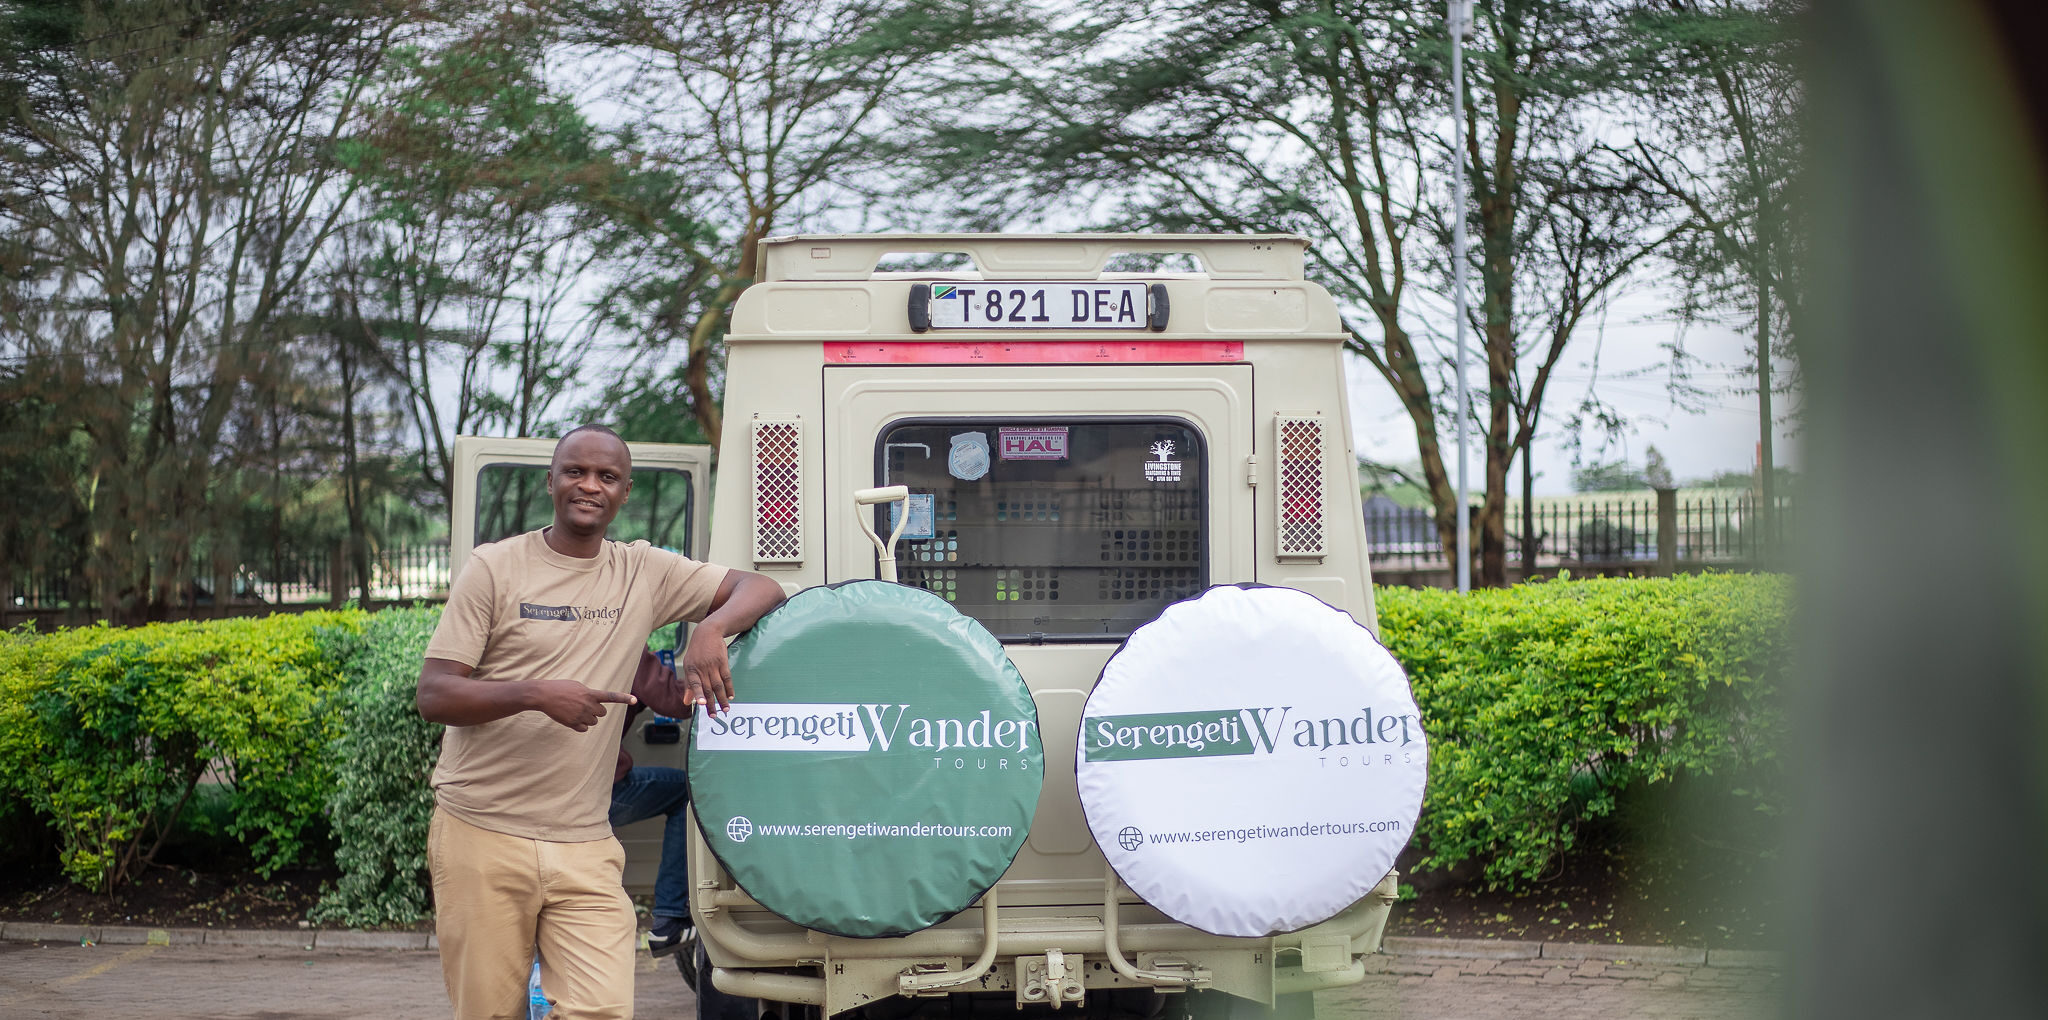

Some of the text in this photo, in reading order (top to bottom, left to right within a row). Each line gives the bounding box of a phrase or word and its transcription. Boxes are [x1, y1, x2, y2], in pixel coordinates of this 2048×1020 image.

[957, 289, 1136, 323] T 821 DEA
[1006, 440, 1062, 452] HAL
[1144, 462, 1182, 471] LIVINGSTONE
[710, 703, 1036, 753] Serengeti Wander
[1096, 706, 1419, 755] Serengeti Wander
[933, 757, 1029, 771] TOURS
[1318, 753, 1412, 769] TOURS
[758, 822, 1013, 841] www.serengetiwandertours.com
[1149, 819, 1401, 845] www.serengetiwandertours.com
[1254, 953, 1263, 964] H
[834, 963, 844, 975] H
